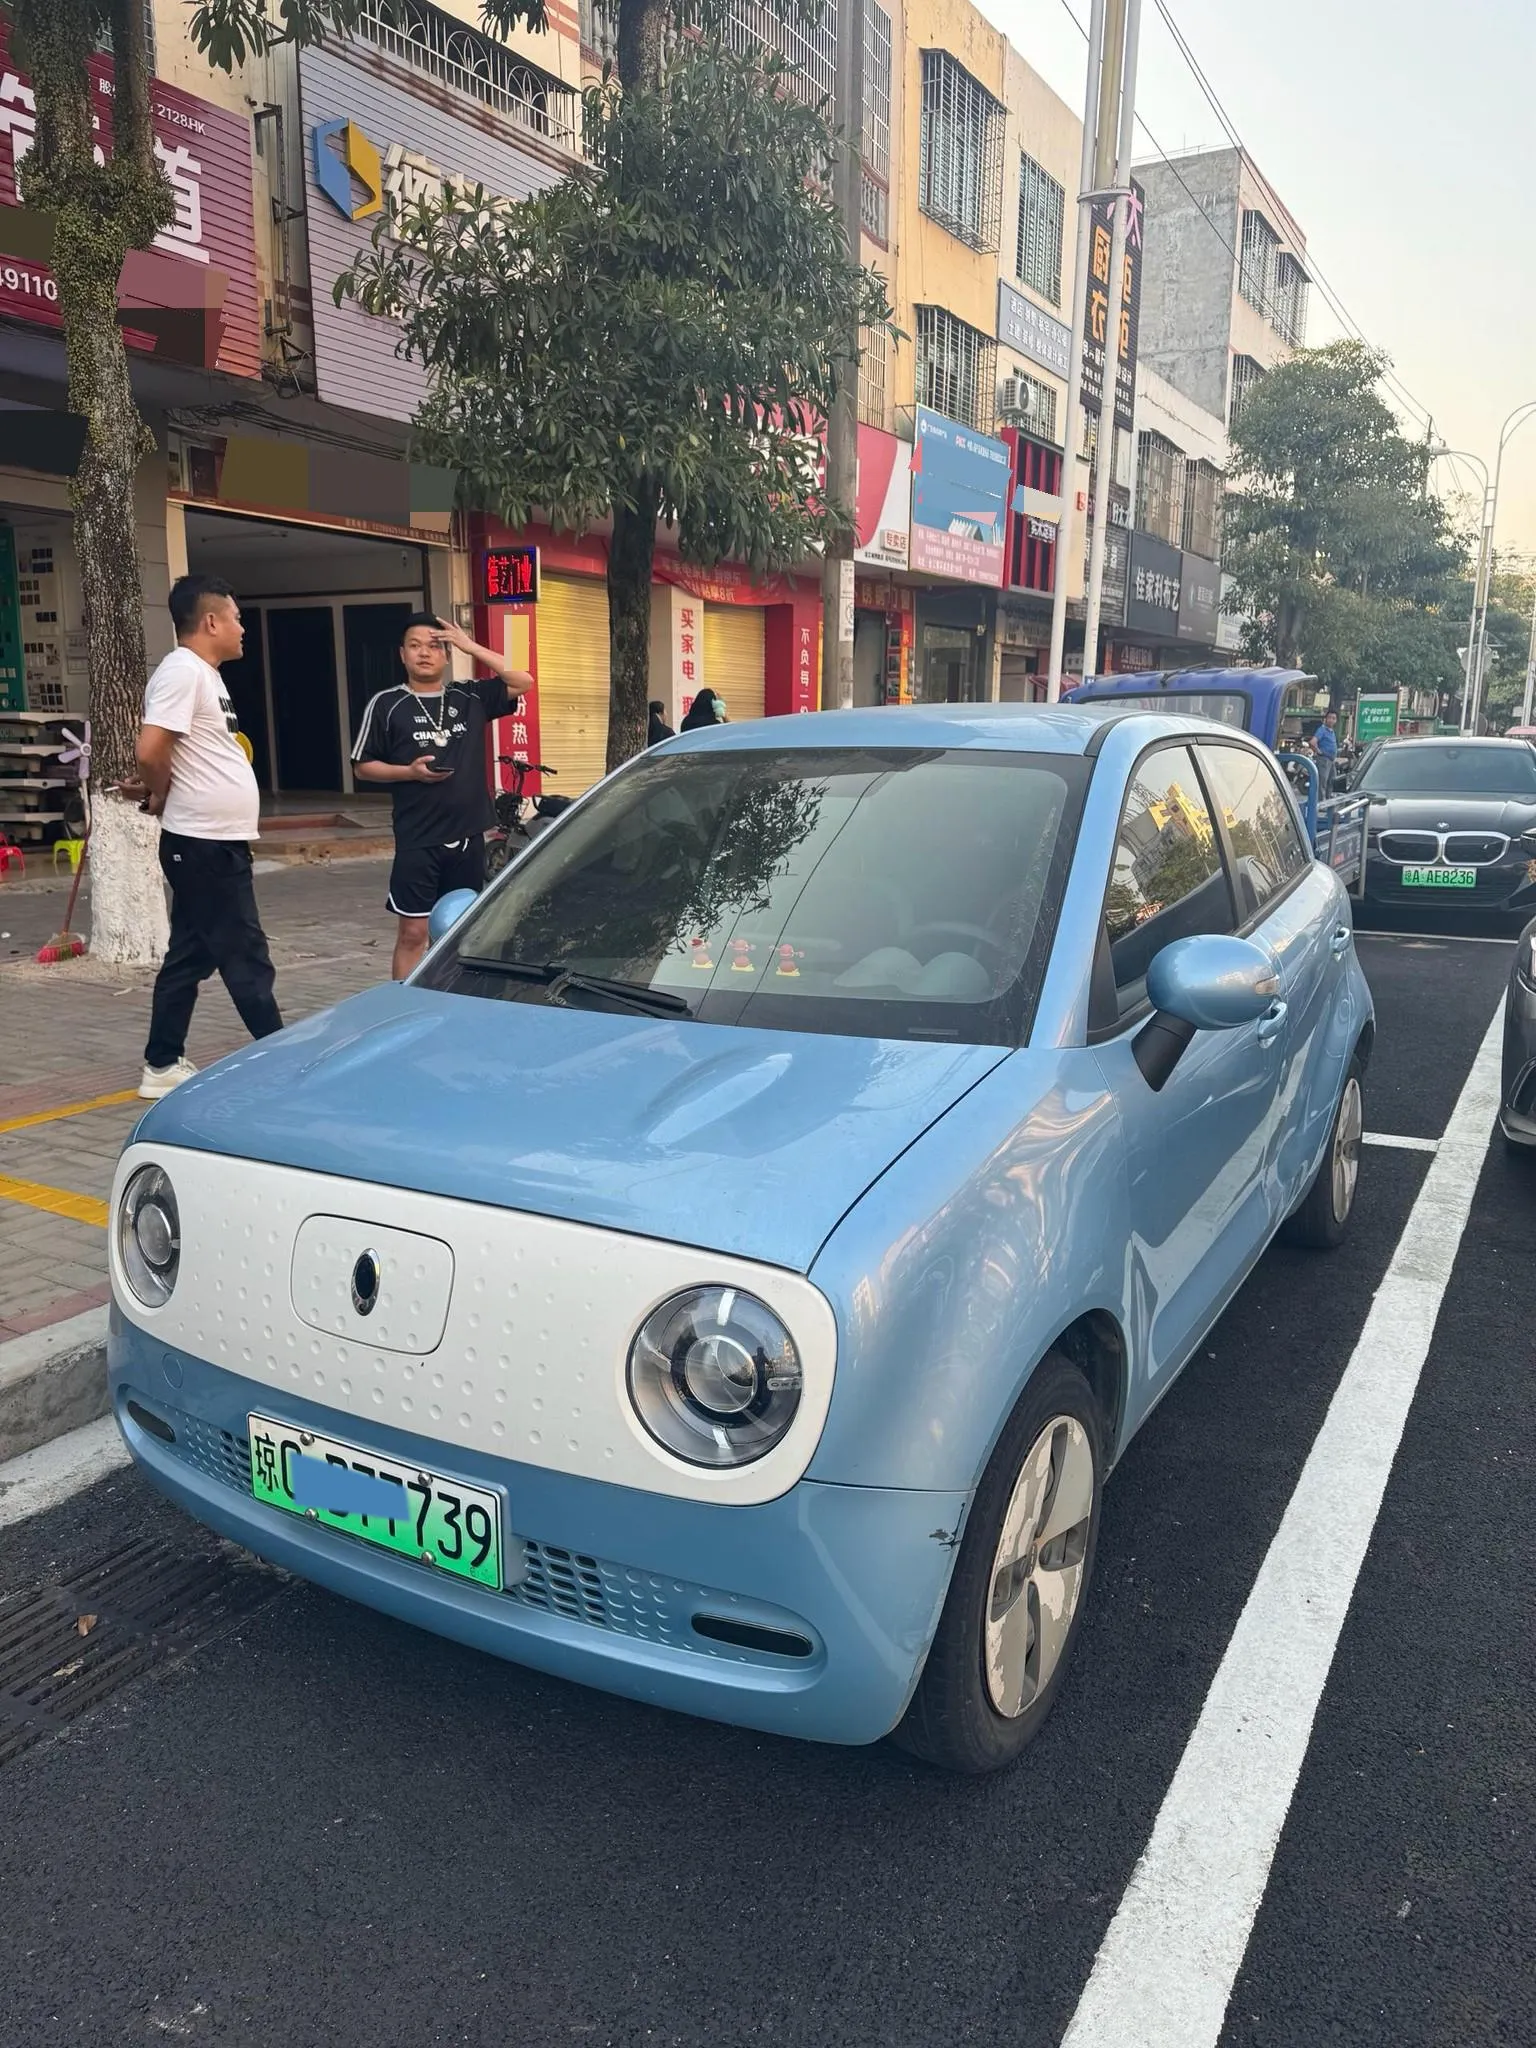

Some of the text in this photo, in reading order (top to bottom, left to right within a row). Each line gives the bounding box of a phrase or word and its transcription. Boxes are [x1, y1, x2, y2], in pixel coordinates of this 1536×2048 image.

[157, 103, 206, 136] 2128.HK
[0, 267, 58, 301] 9110
[886, 531, 907, 550] 专卖店
[681, 607, 695, 681] 买家电
[1426, 870, 1474, 885] AE8236
